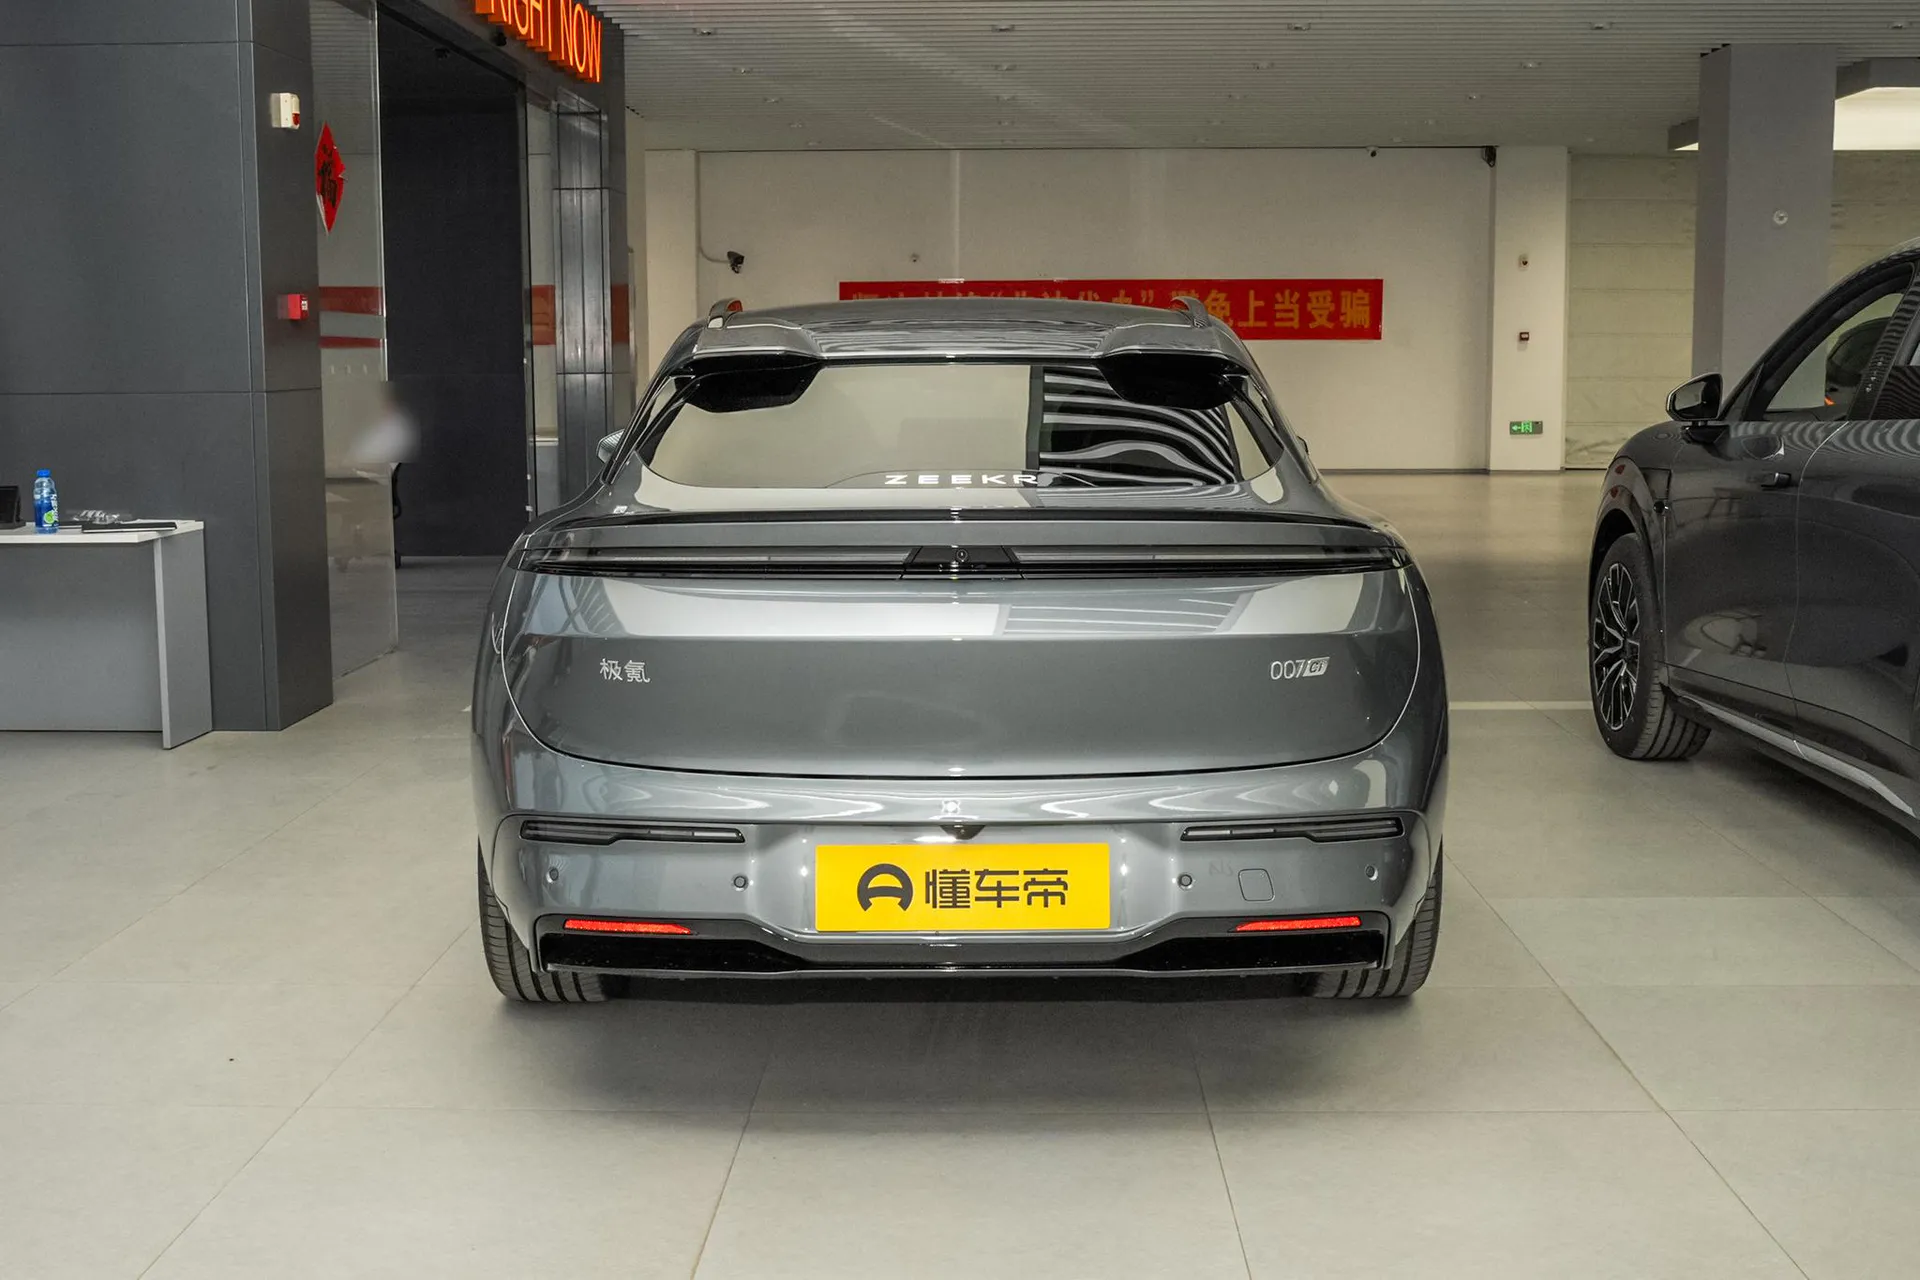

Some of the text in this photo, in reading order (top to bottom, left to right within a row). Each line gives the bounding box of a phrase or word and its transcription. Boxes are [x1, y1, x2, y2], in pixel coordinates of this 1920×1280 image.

[560, 0, 601, 83] NOW
[884, 474, 1038, 485] ZEEKR
[599, 658, 651, 683] 极氪
[925, 868, 1069, 909] 懂车帝
